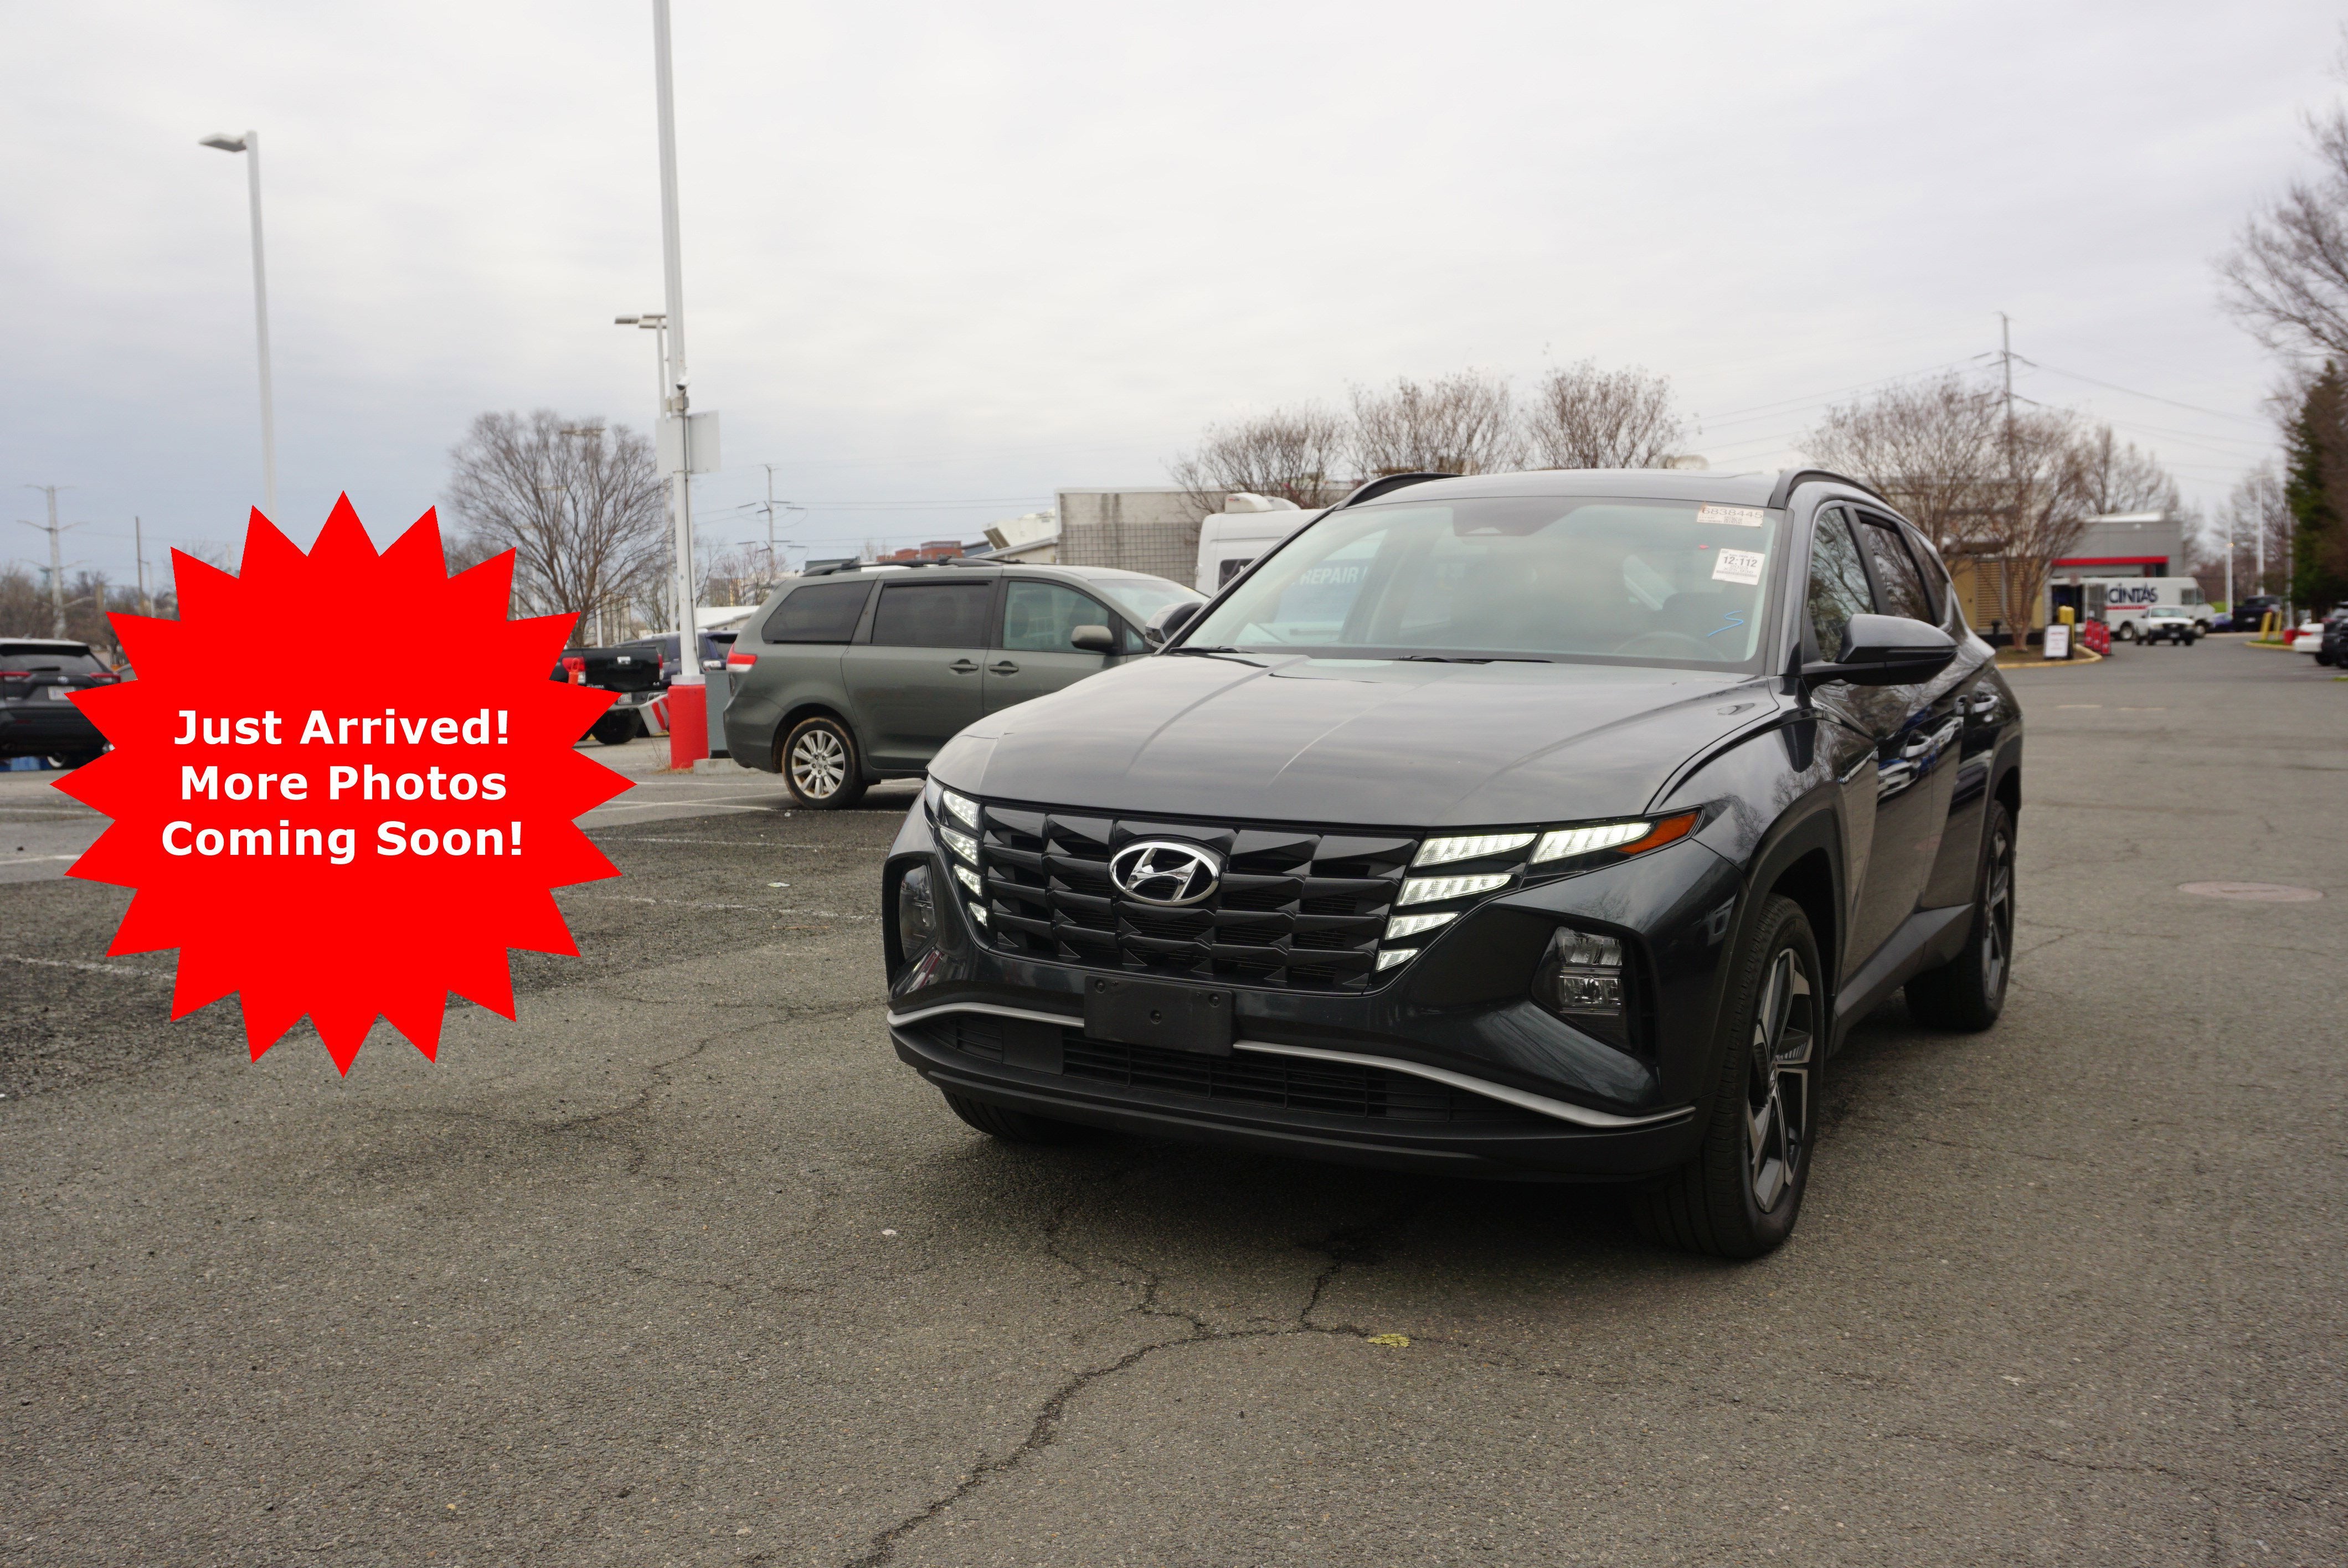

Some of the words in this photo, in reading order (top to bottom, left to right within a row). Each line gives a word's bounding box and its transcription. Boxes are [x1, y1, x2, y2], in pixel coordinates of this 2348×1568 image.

[1702, 507, 1763, 518] 6838445
[1300, 566, 1359, 585] REPAIR
[2108, 582, 2159, 604] CINTAS
